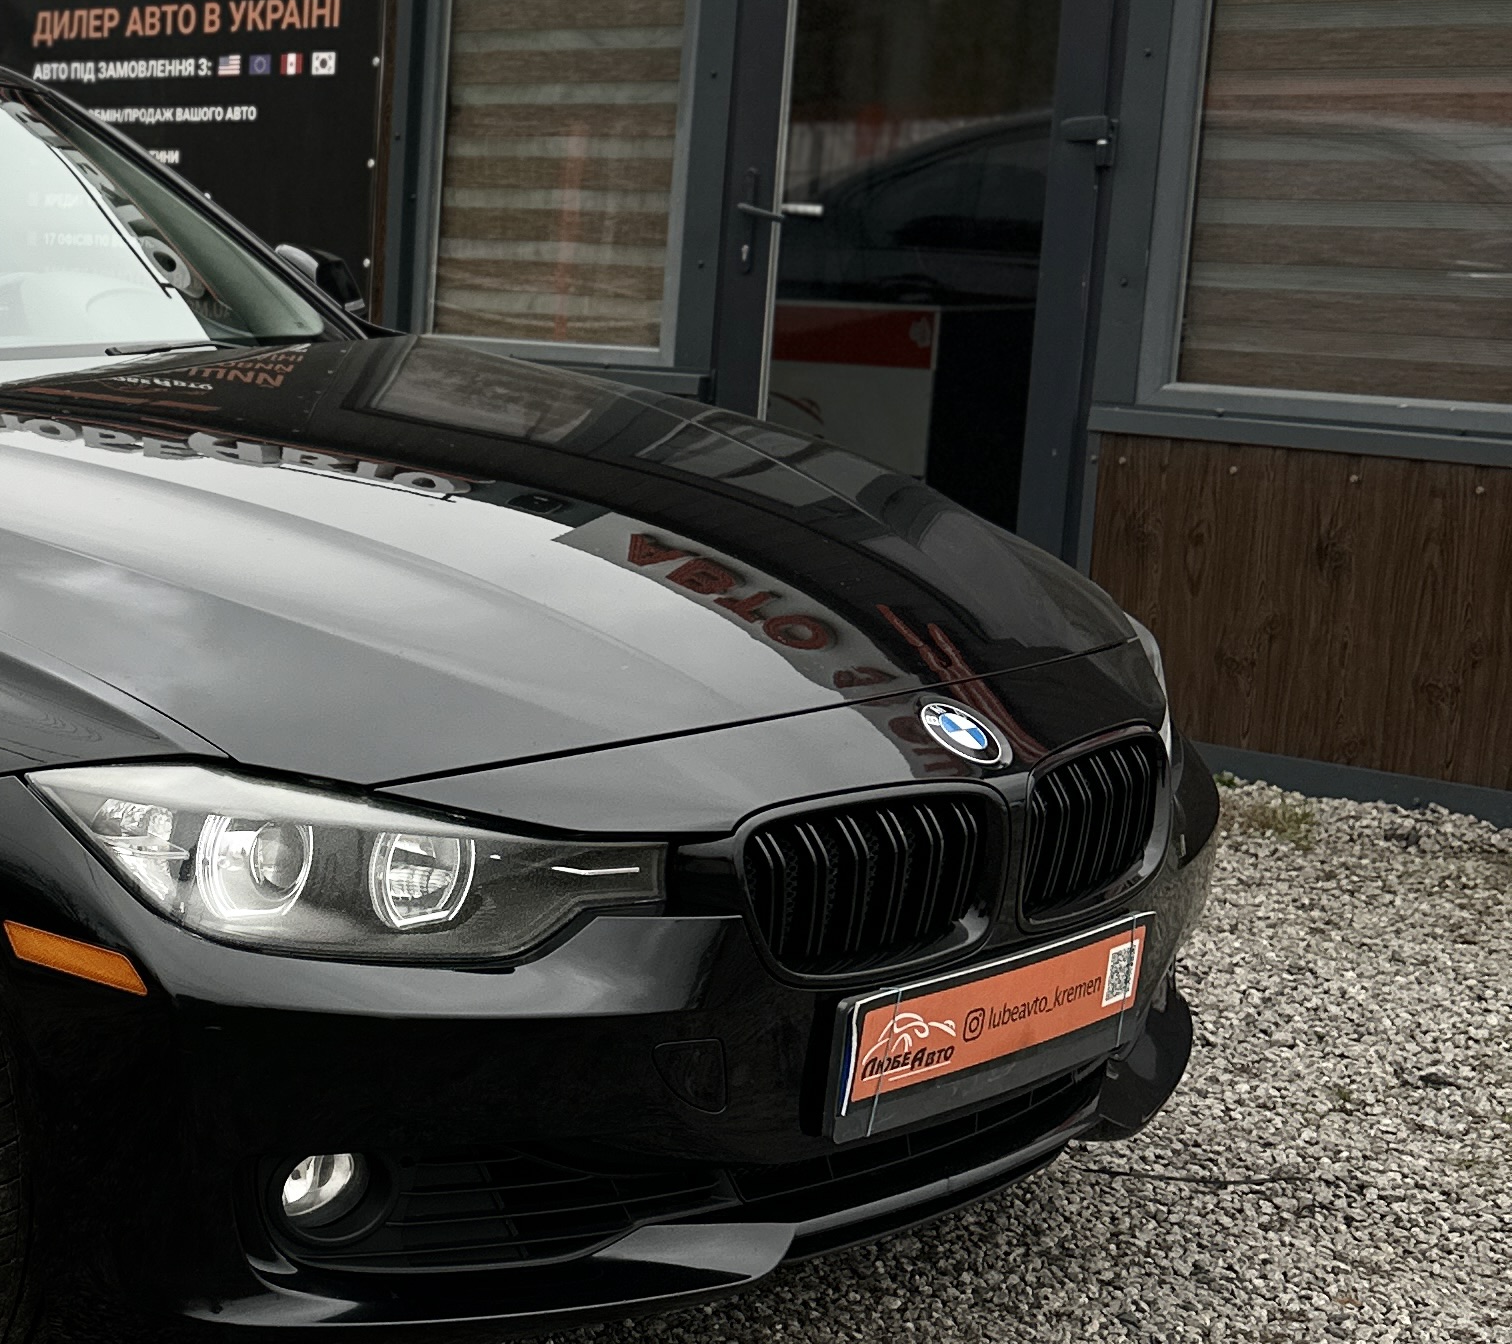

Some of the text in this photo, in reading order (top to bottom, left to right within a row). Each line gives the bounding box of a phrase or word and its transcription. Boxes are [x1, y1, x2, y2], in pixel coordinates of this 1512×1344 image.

[33, 7, 120, 47] ДИЛЕР
[125, 3, 197, 38] АВТО
[203, 1, 222, 34] В
[33, 62, 68, 81] АВТО
[70, 62, 96, 84] ПІД
[97, 59, 195, 80] ЗАМОВЛЕННЯ
[175, 107, 224, 122] ВАШОГО
[225, 105, 257, 121] АВТО
[987, 976, 1102, 1030] lubeavto_kremen
